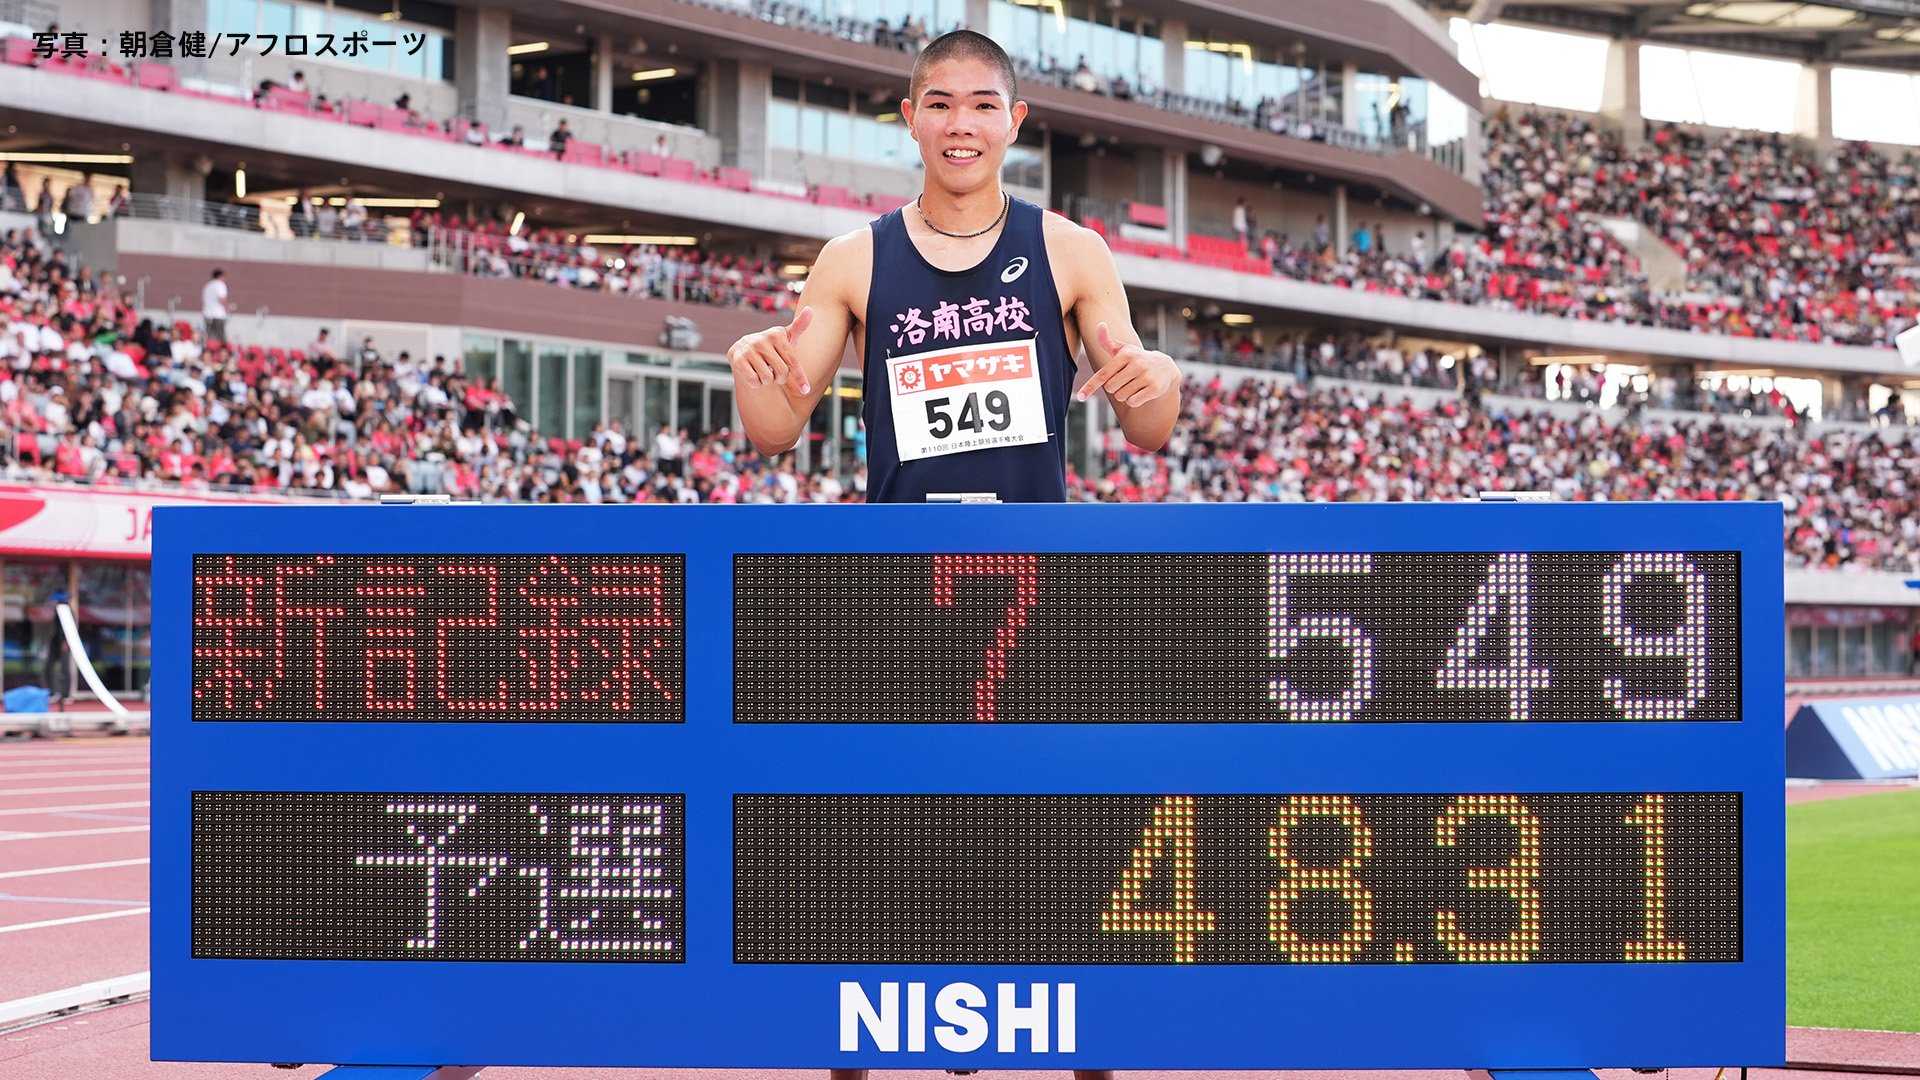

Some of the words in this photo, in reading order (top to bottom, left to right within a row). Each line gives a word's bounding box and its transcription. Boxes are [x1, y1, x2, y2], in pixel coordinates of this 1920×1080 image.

[889, 296, 1034, 348] 洛南高校
[928, 353, 1025, 383] ヤマザキ
[924, 389, 1012, 439] 549
[194, 555, 674, 712] 新記録
[933, 554, 1038, 722] 7
[1267, 552, 1706, 721] 549
[355, 803, 674, 952] 予選
[1101, 794, 1687, 964] 48.31
[838, 981, 1077, 1054] NISHI
